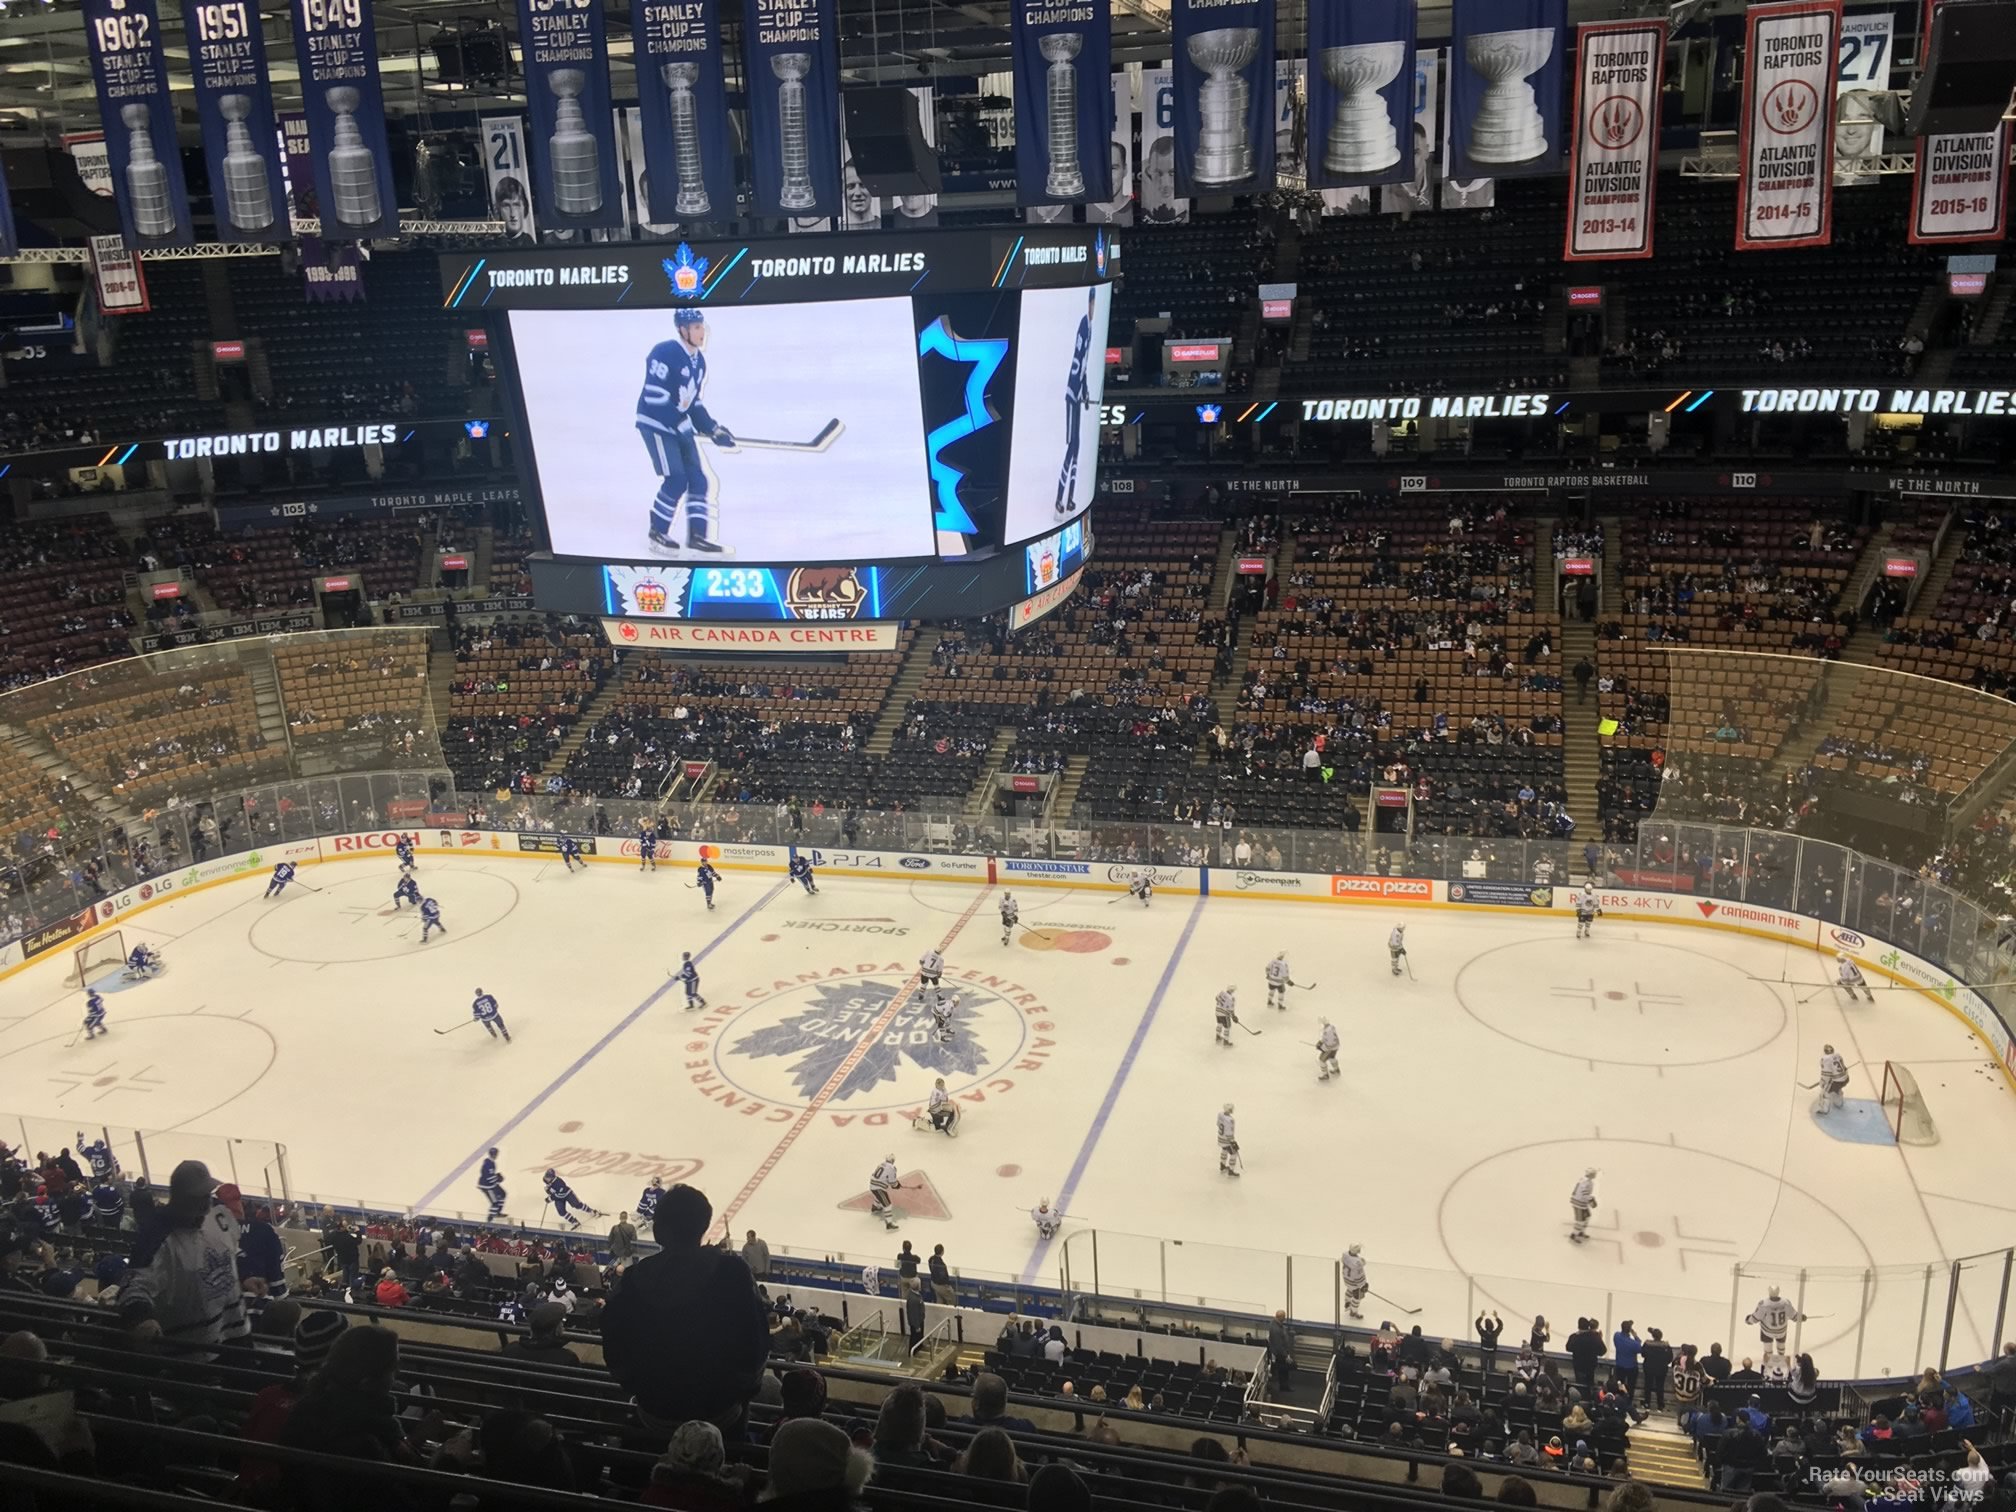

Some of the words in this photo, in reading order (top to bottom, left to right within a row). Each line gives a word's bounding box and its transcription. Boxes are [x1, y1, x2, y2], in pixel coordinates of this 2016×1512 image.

[644, 3, 704, 22] STANLEY
[758, 0, 817, 11] STANLEY
[196, 2, 249, 42] 1951
[302, 0, 362, 33] 1949
[532, 13, 589, 32] STANLEY
[775, 11, 803, 27] CUP
[1026, 7, 1094, 25] CHAMPIONS
[94, 13, 152, 53] 1962
[662, 22, 689, 39] CUP
[759, 28, 820, 44] CHAMPIONS
[308, 32, 362, 52] STANLEY
[550, 32, 576, 47] CUP
[647, 38, 707, 54] CHAMPIONS
[1765, 33, 1823, 53] TORONTO
[201, 41, 251, 60] STANLEY
[325, 51, 349, 67] CUP
[535, 47, 593, 63] CHAMPIONS
[1593, 50, 1649, 68] TORONTO
[1839, 33, 1889, 82] 27
[102, 52, 152, 71] STANLEY
[217, 58, 241, 74] CUP
[1763, 50, 1822, 70] RAPTORS
[119, 68, 141, 84] CUP
[204, 73, 257, 89] CHAMPIONS
[312, 65, 367, 81] CHAMPIONS
[1591, 68, 1647, 86] RAPTORS
[107, 82, 158, 98] CHAMPIONS
[490, 132, 521, 170] 21
[1759, 143, 1817, 162] ATLANTIC
[1933, 136, 1994, 155] ATLANTIC
[1586, 159, 1642, 177] ATLANTIC
[1758, 160, 1815, 179] DIVISION
[1932, 153, 1993, 172] DIVISION
[1584, 176, 1641, 193] DIVISION
[1757, 177, 1815, 192] CHAMPIONS
[1931, 171, 1992, 185] CHAMPIONS
[1583, 193, 1640, 206] CHAMPIONS
[1930, 197, 1987, 216] 2015-16
[1756, 203, 1811, 221] 2014-15
[1582, 218, 1636, 235] 2013-14
[1023, 246, 1061, 266] TORONTO
[1061, 245, 1088, 263] MARLIES
[751, 256, 834, 279] TORONTO
[842, 252, 926, 275] MARLIES
[487, 267, 554, 289] TORONTO
[558, 264, 630, 286] MARLIES
[648, 359, 669, 380] 38
[1302, 398, 1421, 421] TORONTO
[1430, 394, 1550, 418] MARLIES
[1741, 389, 1881, 413] TORONTO
[1888, 390, 2016, 415] MARLIES
[163, 432, 280, 460] TORONTO
[290, 424, 397, 451] MARLIES
[1112, 481, 1133, 492] 108
[1242, 480, 1260, 491] THE
[1263, 480, 1300, 491] NORTH
[1402, 477, 1425, 489] 109
[1503, 477, 1545, 487] TORONTO
[1548, 476, 1590, 487] RAPTORS
[1592, 474, 1649, 486] BASKETBALL
[1733, 474, 1755, 486] 110
[1907, 479, 1931, 491] THE
[1935, 480, 1980, 493] NORTH
[371, 494, 426, 507] TORONTO
[434, 491, 473, 503] MAPLE
[481, 489, 520, 501] LEAFS
[283, 504, 304, 515] 105
[706, 569, 765, 599] 2:33
[402, 606, 424, 617] IBM
[456, 602, 476, 613] IBM
[483, 600, 504, 612] IBM
[804, 608, 847, 620] BEARS
[260, 620, 281, 632] IBM
[288, 614, 311, 628] IBM
[232, 625, 254, 636] IBM
[650, 627, 684, 640] AIR
[691, 628, 782, 643] CANADA
[789, 628, 879, 643] CENTRE
[284, 845, 315, 856] CCM
[723, 846, 776, 857] masterpass
[199, 854, 263, 879] environmental
[832, 853, 882, 868] PS4
[903, 856, 927, 869] Ford
[940, 862, 951, 870] Go
[952, 861, 977, 871] Further
[1009, 860, 1058, 872] TORONTO
[1058, 863, 1087, 874] STAR
[1026, 871, 1067, 881] thestar.com
[1254, 875, 1301, 887] Greenpark
[154, 878, 173, 894] LG
[1336, 879, 1380, 894] pizza
[1383, 881, 1428, 896] pizza
[115, 894, 132, 911] LG
[1569, 893, 1629, 907] RERS
[1633, 897, 1652, 909] 4K
[1654, 898, 1674, 910] TV
[1721, 905, 1776, 925] CANADIAN
[1778, 913, 1801, 930] TIRE
[782, 920, 911, 937] SPORTCHEK
[25, 936, 42, 953] Tim
[42, 925, 72, 946] Hortons
[1837, 930, 1859, 947] AHL
[929, 956, 938, 969] 7
[1273, 965, 1280, 977] 3
[744, 960, 906, 1000] CANADA
[940, 964, 1047, 1016] CENTRE
[478, 1003, 494, 1015] 38
[1963, 1005, 1985, 1029] CISCO
[691, 1004, 743, 1037] AIR
[1013, 1036, 1057, 1073] AIR
[684, 1056, 796, 1127] CENTRE
[216, 1212, 229, 1232] C
[1769, 1310, 1787, 1328] 18
[1674, 1373, 1698, 1394] 30
